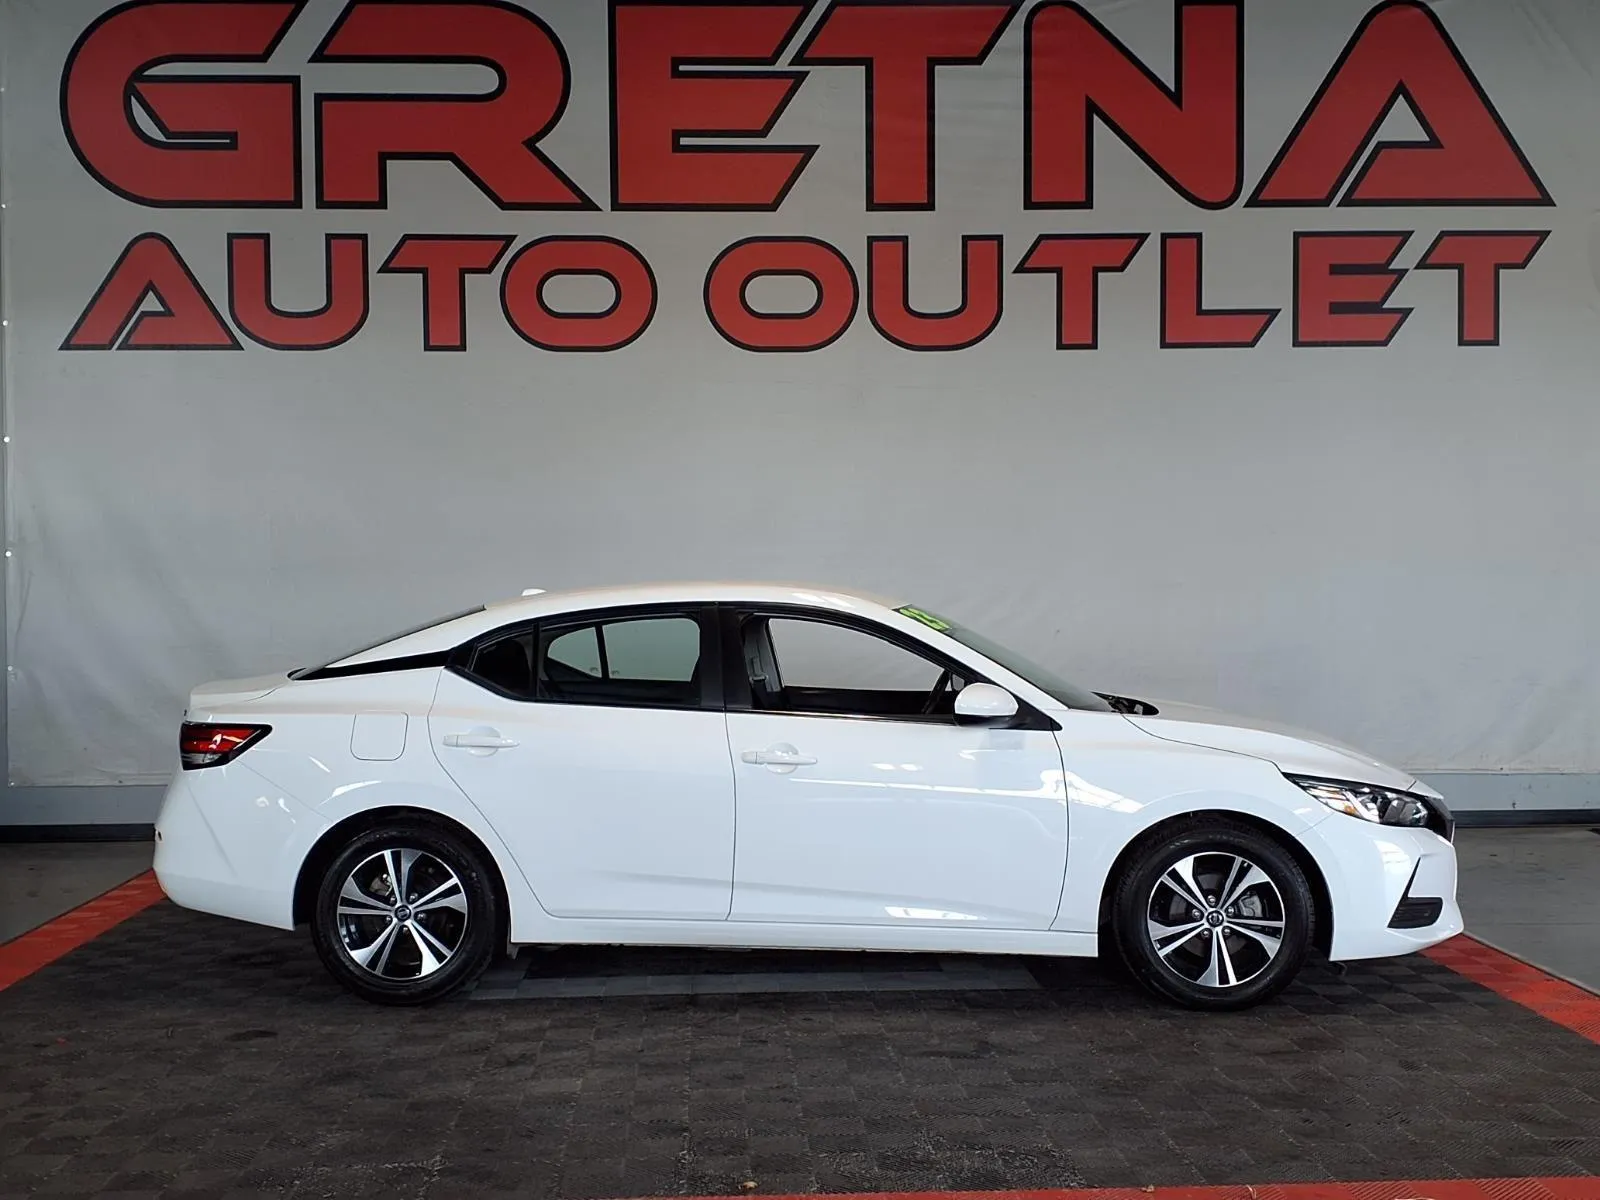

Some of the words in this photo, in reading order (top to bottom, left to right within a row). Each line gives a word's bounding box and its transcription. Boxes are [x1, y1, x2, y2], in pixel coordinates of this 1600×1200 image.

[60, 0, 1556, 212] GRETNA
[58, 232, 658, 352] AUTO
[703, 230, 1552, 352] OUTLET
